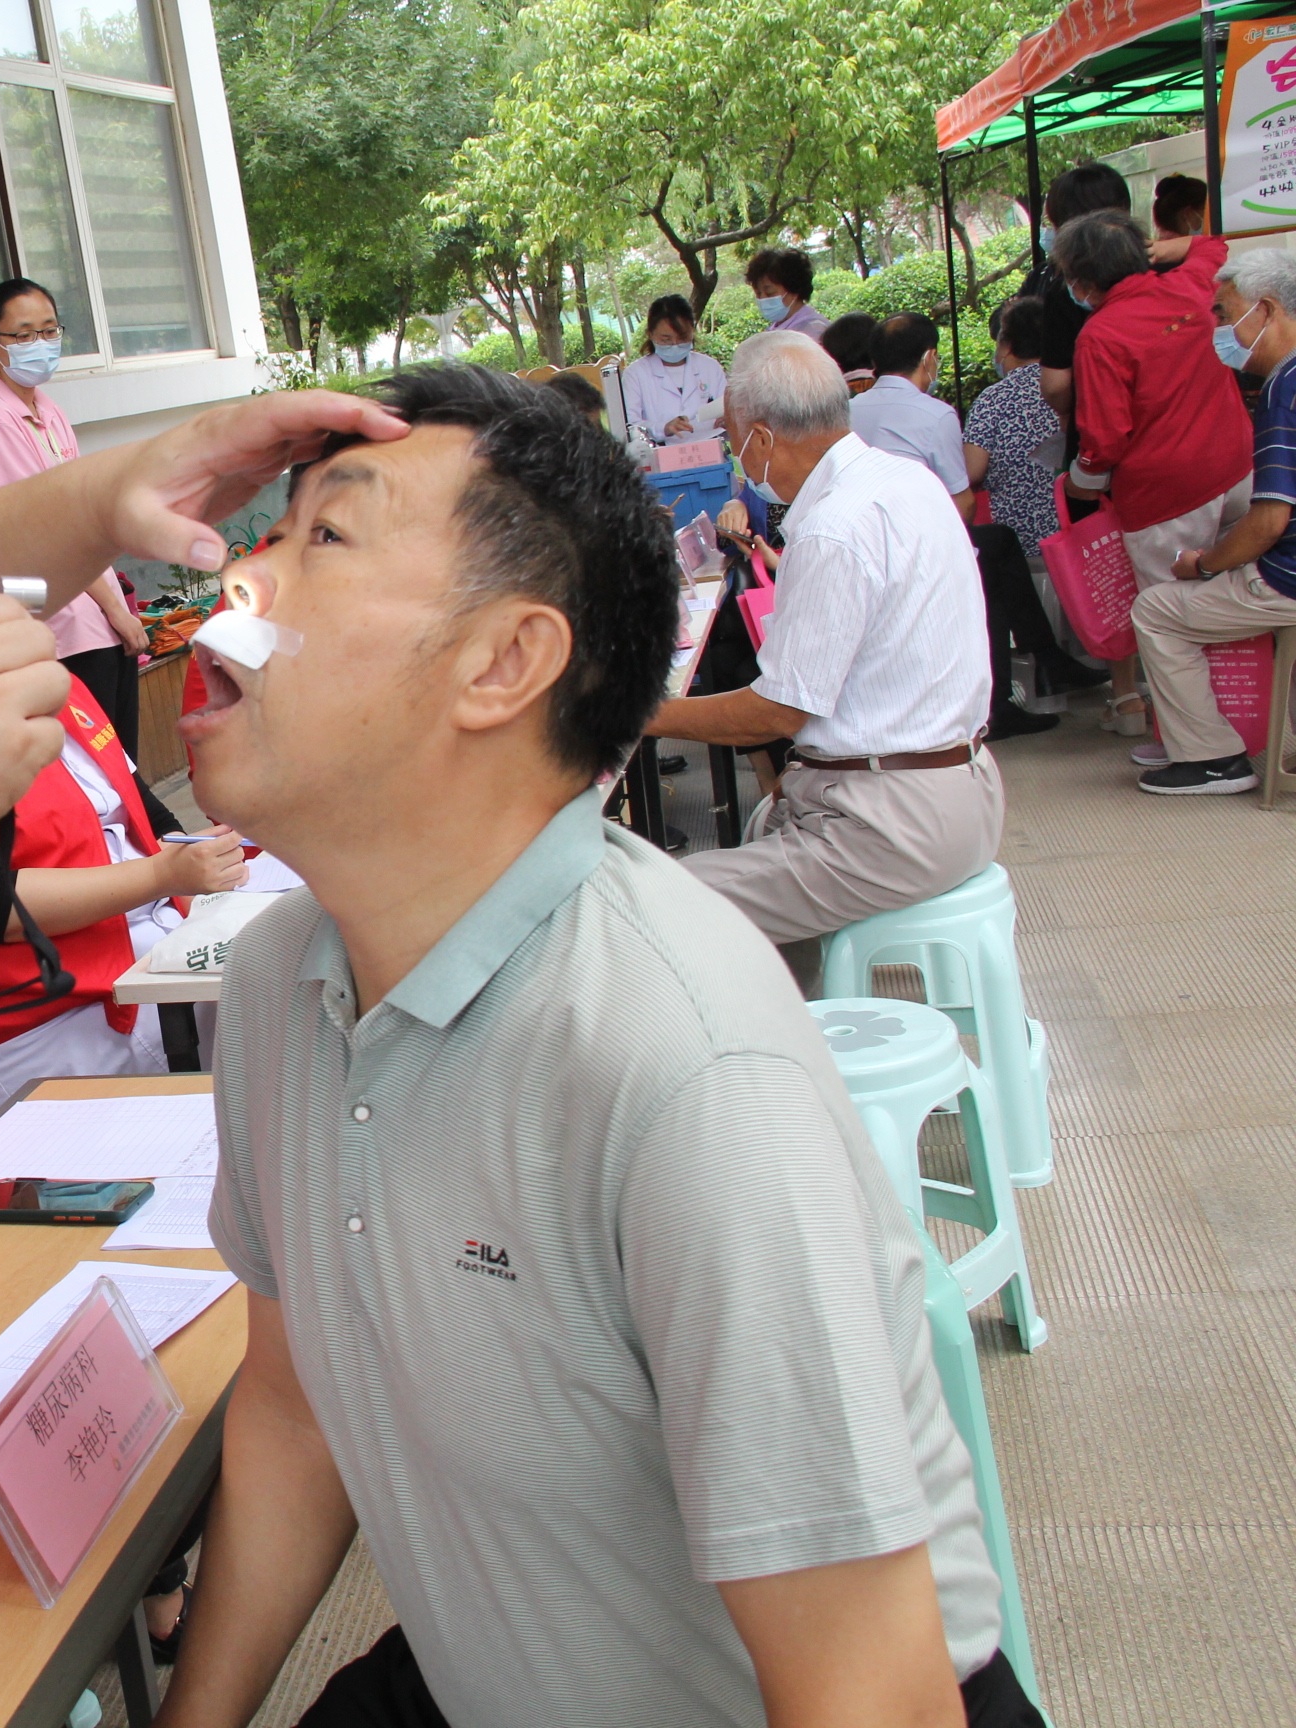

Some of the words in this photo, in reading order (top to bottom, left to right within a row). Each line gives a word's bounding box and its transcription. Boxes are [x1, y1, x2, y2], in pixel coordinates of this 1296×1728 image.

[456, 1259, 517, 1281] FOOTWEAR
[465, 1240, 509, 1267] FILA
[26, 1344, 99, 1447] 糖尿病科
[64, 1405, 118, 1483] 李艳玲
